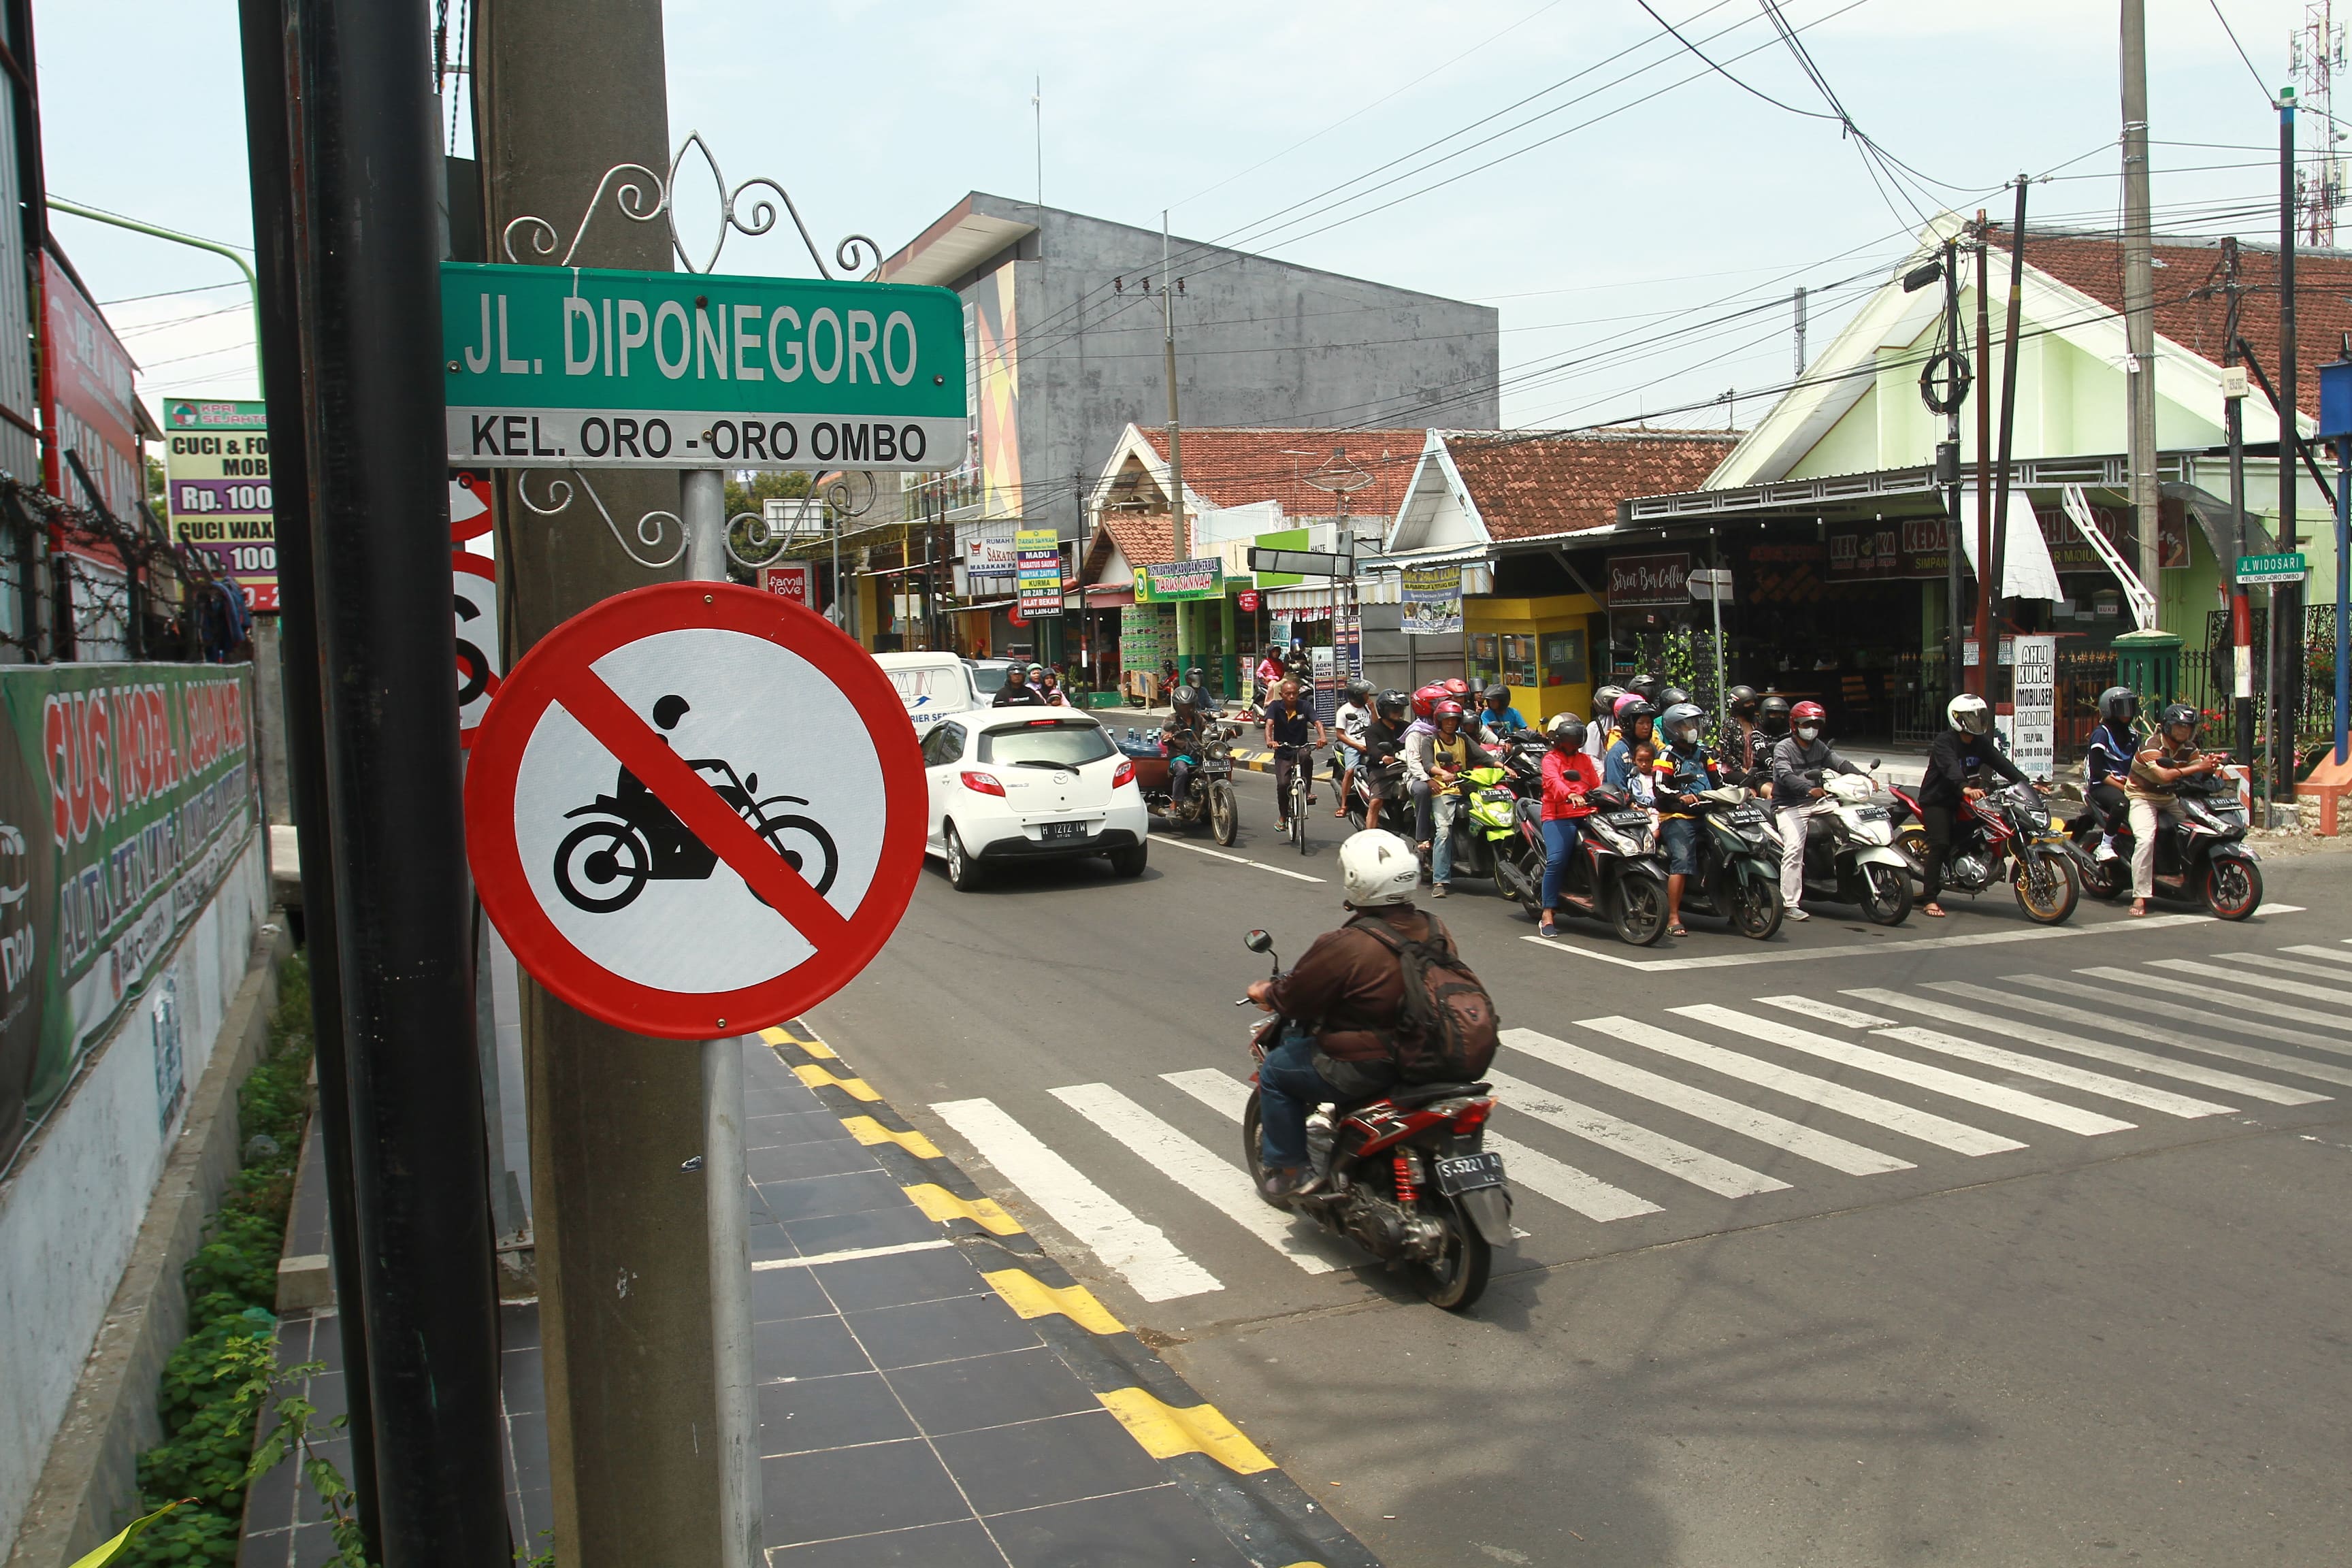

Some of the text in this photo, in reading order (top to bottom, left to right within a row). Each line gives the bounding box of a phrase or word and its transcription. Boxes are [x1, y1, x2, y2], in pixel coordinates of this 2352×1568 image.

[464, 293, 917, 387] JL. DIPONEGORO
[201, 404, 235, 413] KPRI
[172, 437, 221, 455] CUCI
[227, 438, 241, 455] &
[472, 415, 565, 458] KEL.
[581, 417, 672, 459] ORO
[710, 420, 797, 461] ORO
[811, 422, 926, 463] OMBO
[182, 485, 223, 512] Rp.
[178, 521, 274, 540] CUCI WAX
[1026, 551, 1049, 559] MADU
[1916, 557, 1950, 569] SIMPAN
[1147, 559, 1218, 577] DISTRIBUTOR MADU DAN HERBAL
[2241, 557, 2299, 572] JL. WIDOSARI
[1156, 573, 1211, 593] DARUS SUNNAH
[1612, 565, 1685, 591] Street Bar Coffee
[774, 585, 802, 595] love
[1023, 589, 1032, 598] AIR
[1032, 589, 1043, 597] ZAM
[1047, 588, 1058, 596] ZAM
[1023, 598, 1059, 606] ALAT BEKAM
[2022, 645, 2048, 664] AHLI
[2016, 665, 2052, 684] KUNCI
[2016, 688, 2053, 707] IMOBILISER
[2017, 711, 2051, 727] MADIUN
[2024, 748, 2032, 757] 100
[44, 689, 116, 855] CUCI
[1043, 822, 1086, 835] H 1272 IW
[61, 858, 112, 978] AUTO
